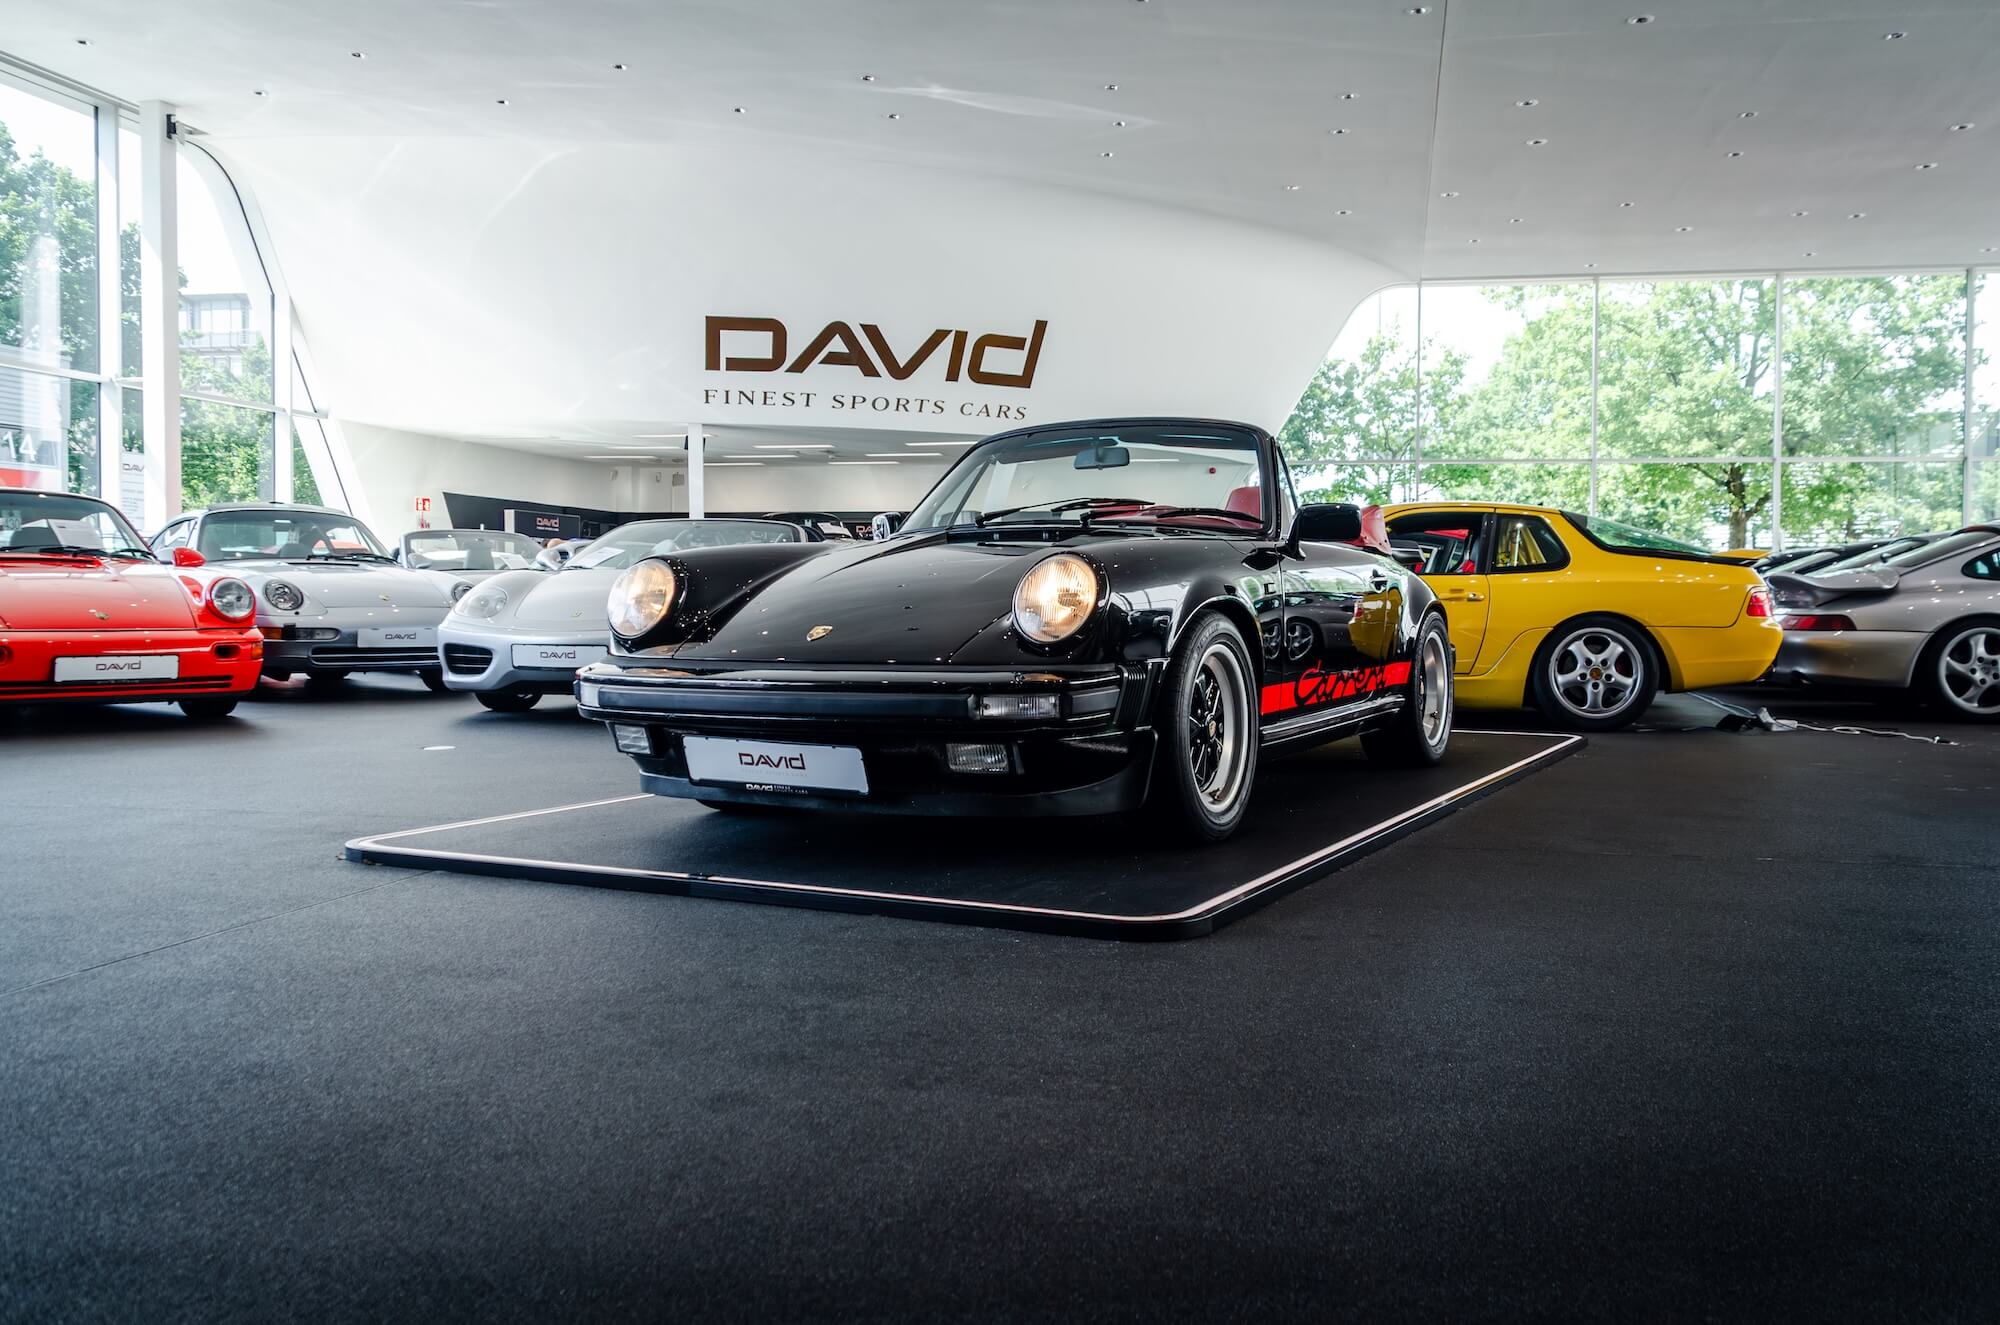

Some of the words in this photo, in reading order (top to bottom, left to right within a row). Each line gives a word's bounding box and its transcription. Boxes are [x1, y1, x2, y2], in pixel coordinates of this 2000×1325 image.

[704, 389, 817, 407] FINEST
[832, 394, 945, 415] SPORTS
[960, 402, 1027, 420] CARS
[1294, 660, 1386, 706] Carrera
